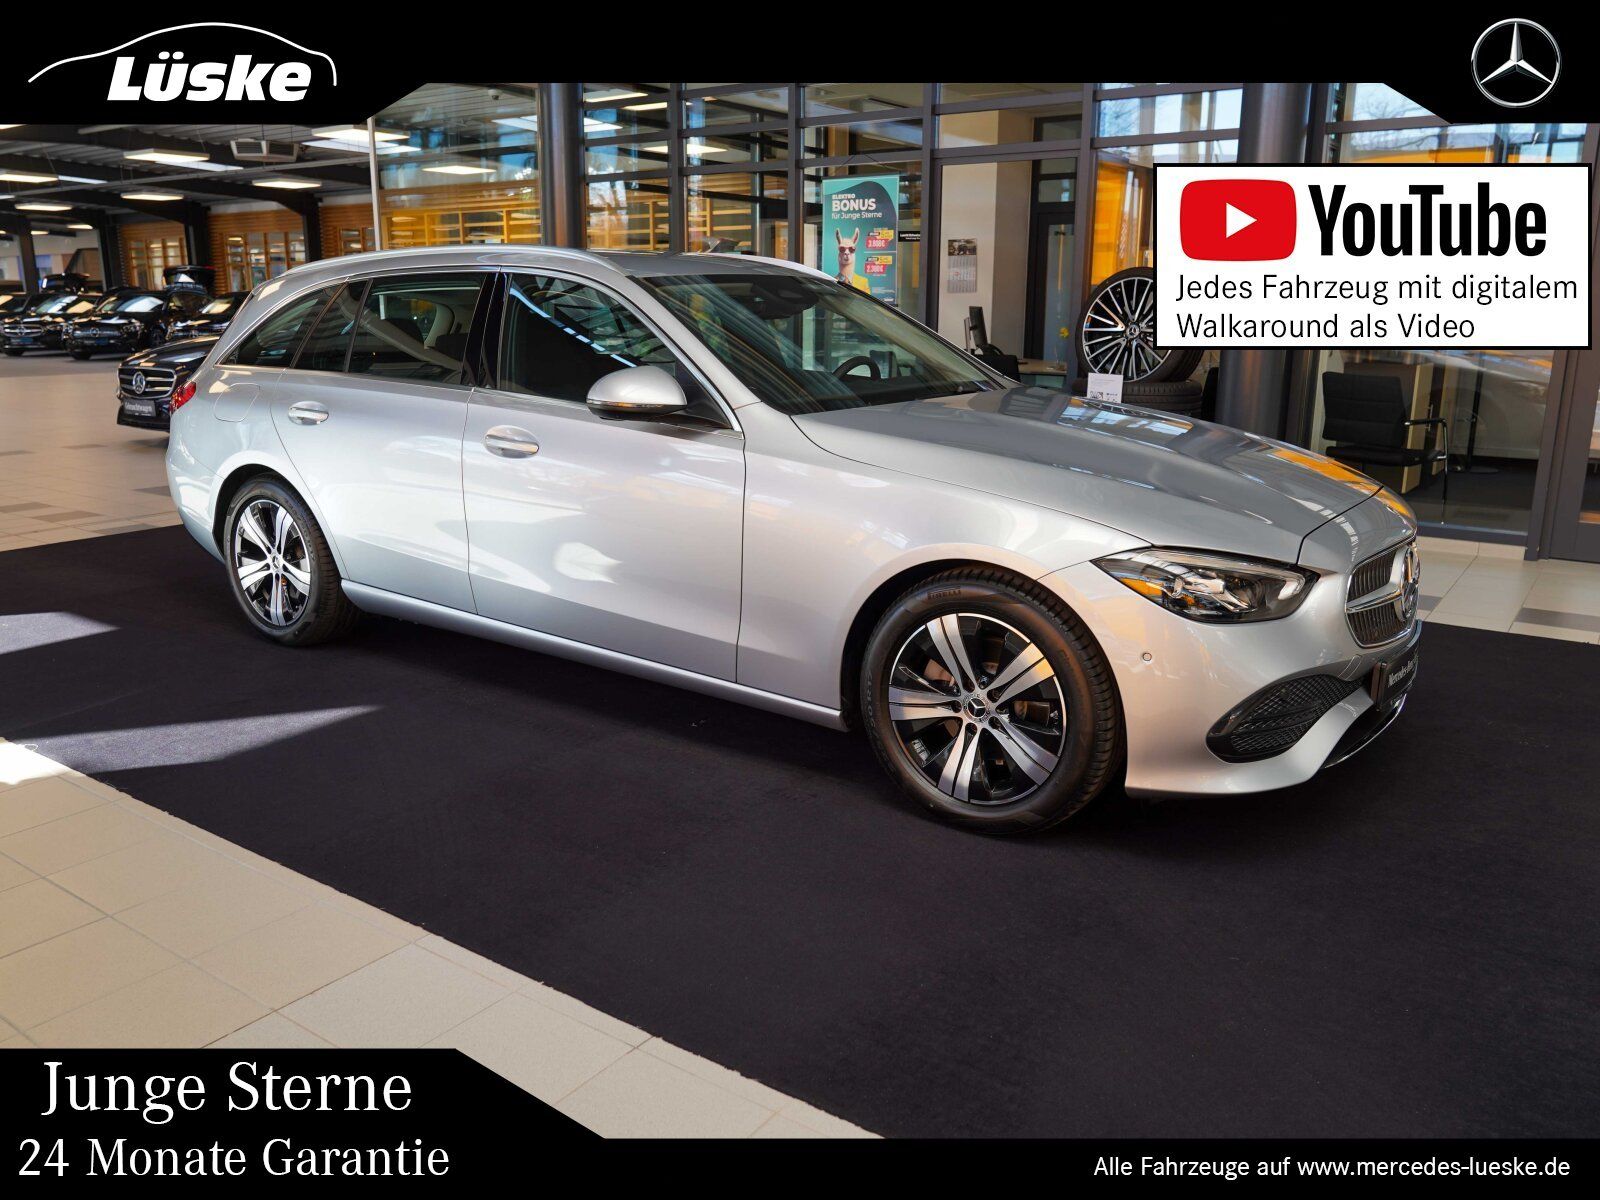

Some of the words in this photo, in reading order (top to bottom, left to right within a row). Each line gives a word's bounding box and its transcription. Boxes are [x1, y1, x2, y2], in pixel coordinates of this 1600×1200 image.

[832, 199, 877, 212] BONUS
[841, 212, 861, 220] Junge
[861, 211, 883, 219] Sterne
